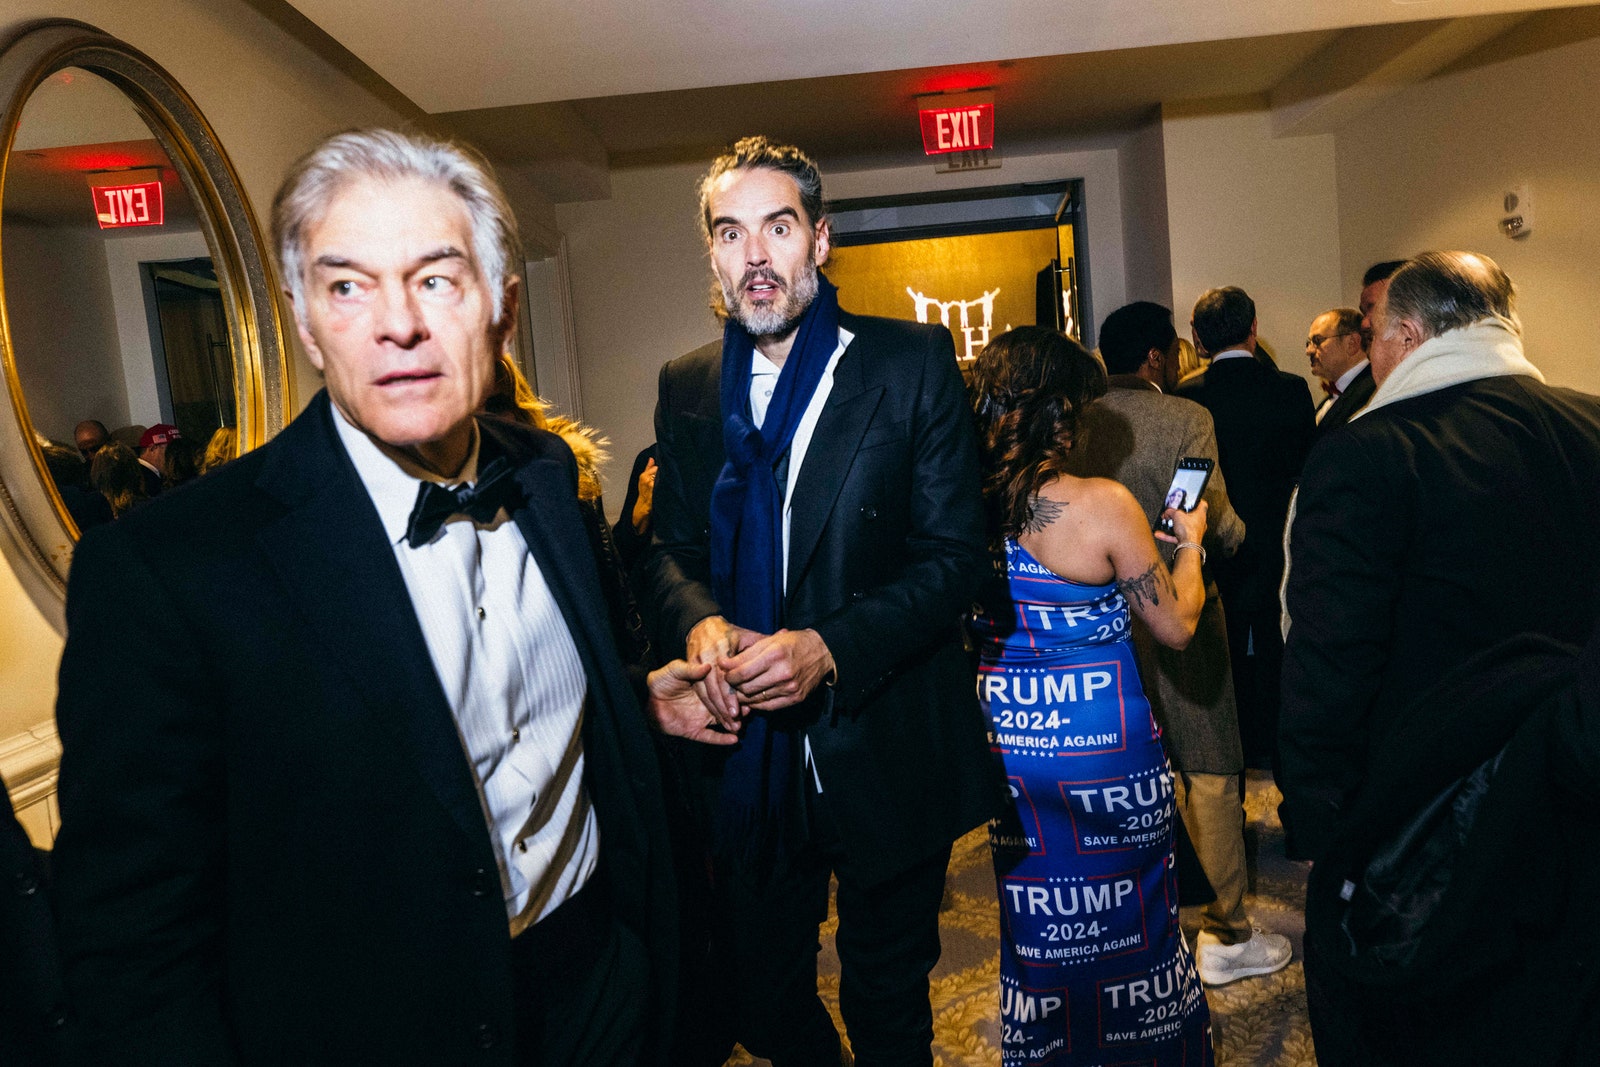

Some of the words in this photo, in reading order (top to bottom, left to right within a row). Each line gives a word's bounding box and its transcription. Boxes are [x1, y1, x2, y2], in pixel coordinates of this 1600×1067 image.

[936, 110, 981, 149] EXIT
[1019, 563, 1057, 576] AGA
[1028, 594, 1127, 630] TRU
[993, 709, 1070, 730] -2024-
[996, 733, 1060, 749] AMERICA
[1063, 733, 1118, 748] AGAIN!
[1084, 836, 1118, 847] SAVE
[1122, 823, 1170, 844] AMERICA
[1006, 879, 1134, 916] TRUMP
[1040, 920, 1108, 942] -2024-
[1015, 944, 1042, 959] SAVE
[1045, 944, 1100, 959] AMERICA
[1103, 933, 1141, 952] AGAIN!
[1000, 984, 1061, 1023] UMP
[1001, 1022, 1033, 1044] 24-
[1106, 1032, 1137, 1042] SAVE
[1140, 1020, 1182, 1038] AMERIC
[1029, 1038, 1064, 1059] AGAIN!
